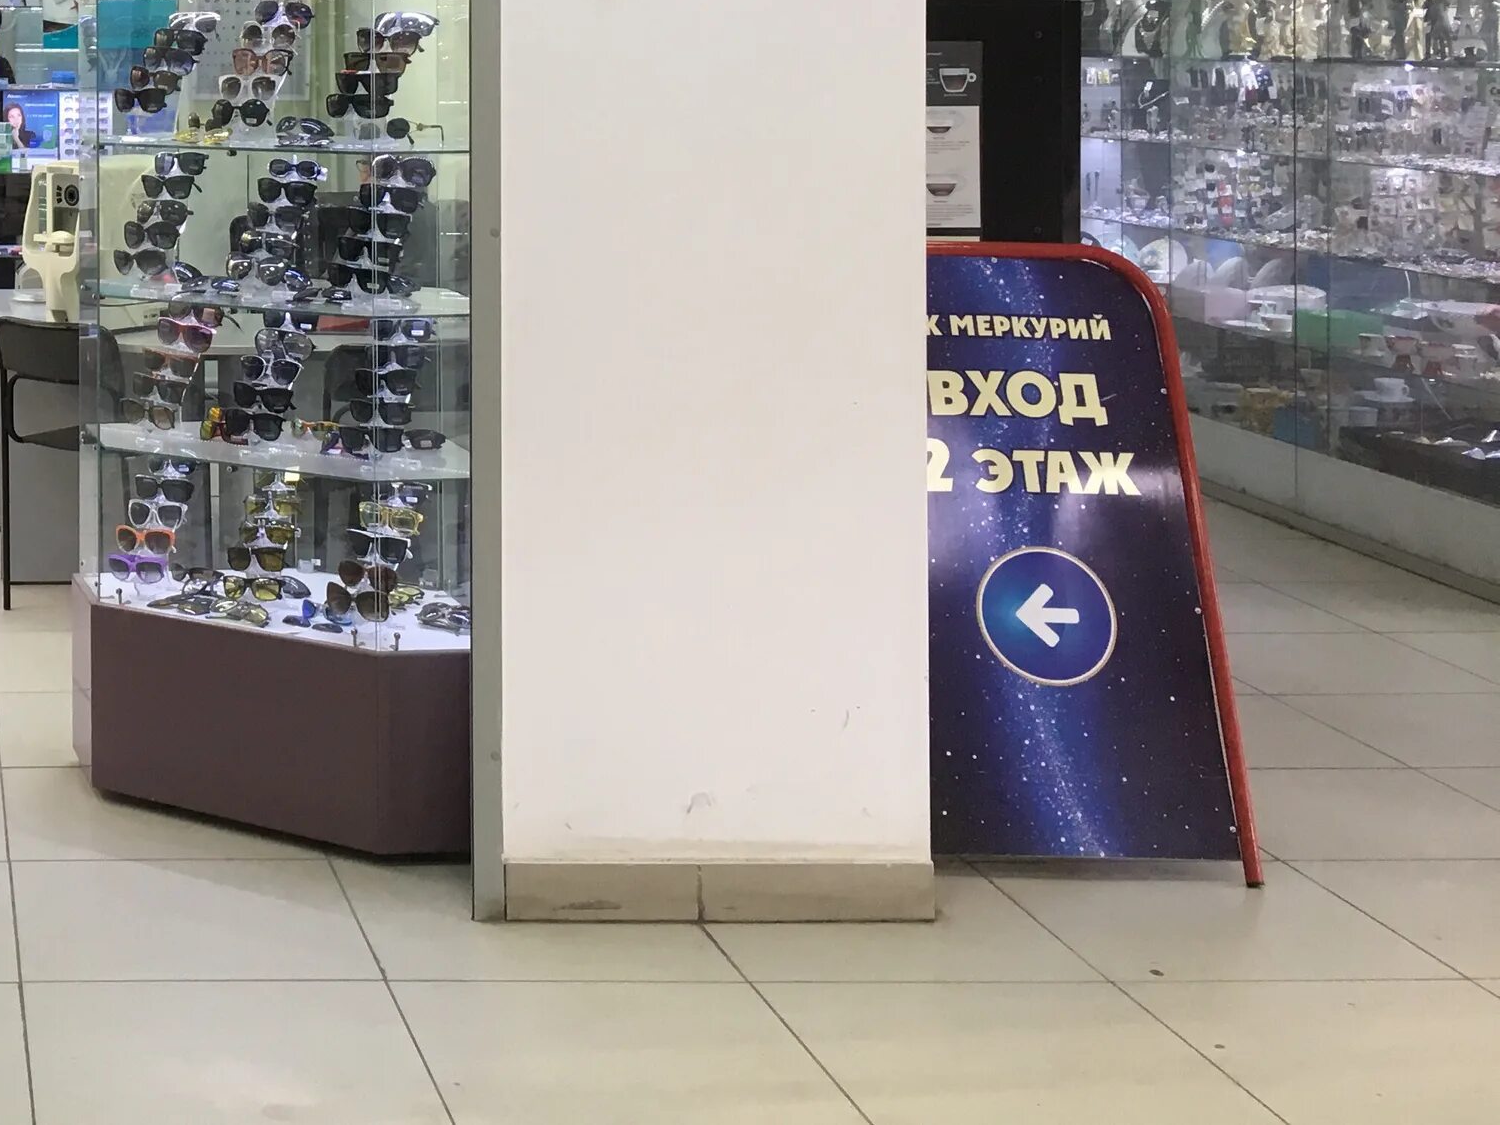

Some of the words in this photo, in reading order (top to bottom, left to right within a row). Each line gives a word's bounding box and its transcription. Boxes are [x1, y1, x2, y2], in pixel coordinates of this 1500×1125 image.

[950, 313, 1112, 340] МЕРКУРИЙ
[927, 370, 1108, 427] ВХОД
[971, 449, 1141, 496] ЭТАЖ
